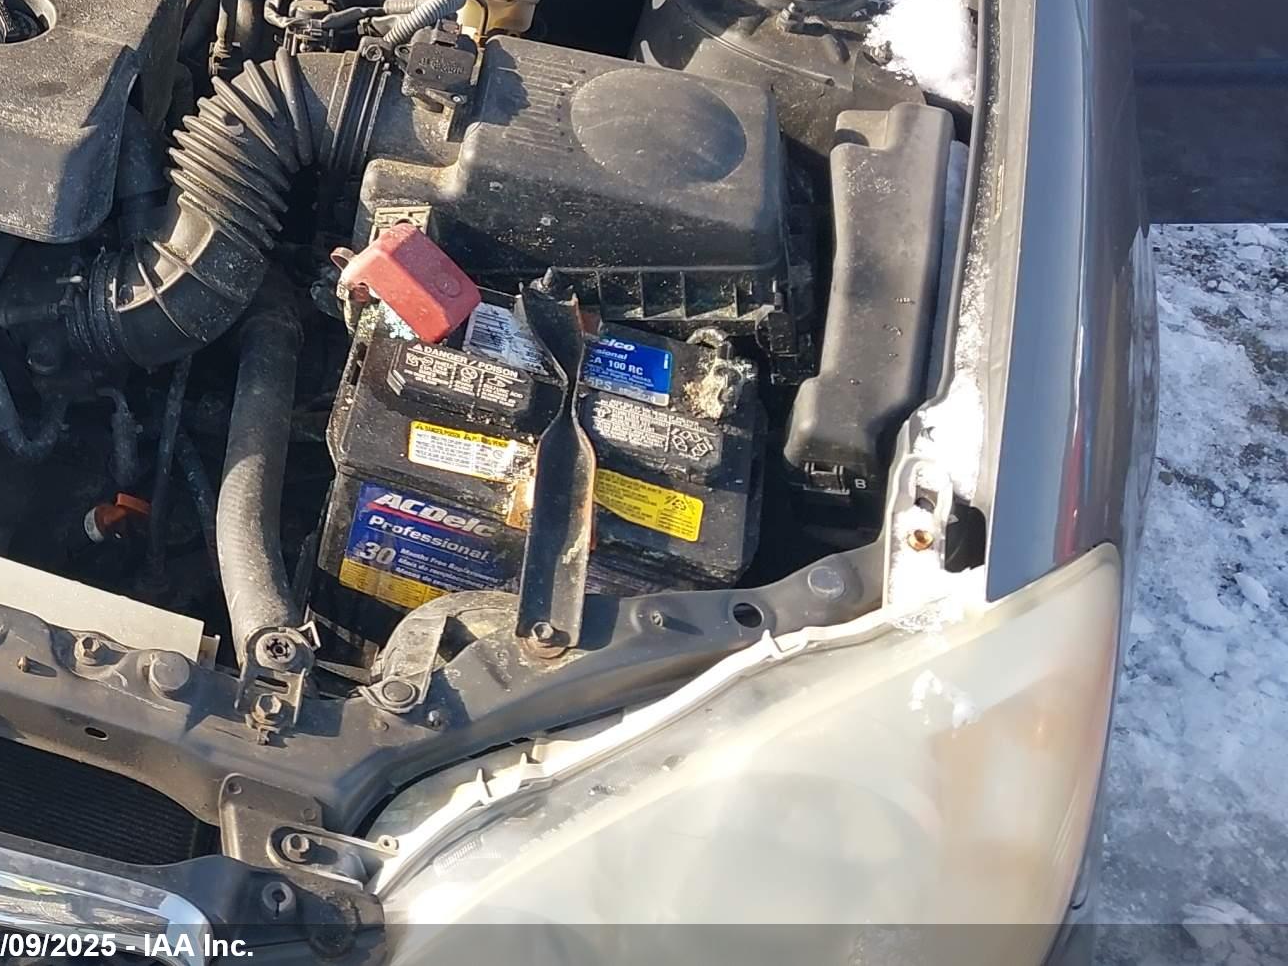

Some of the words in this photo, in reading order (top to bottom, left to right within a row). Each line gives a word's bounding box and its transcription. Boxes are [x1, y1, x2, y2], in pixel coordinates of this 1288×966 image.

[423, 346, 469, 365] DANGER
[477, 362, 519, 378] POISON
[608, 359, 626, 371] 100
[374, 492, 498, 537] ACDelc
[360, 541, 397, 565] 30
[400, 547, 429, 562] Months
[430, 555, 447, 567] Free
[367, 515, 490, 561] Professional
